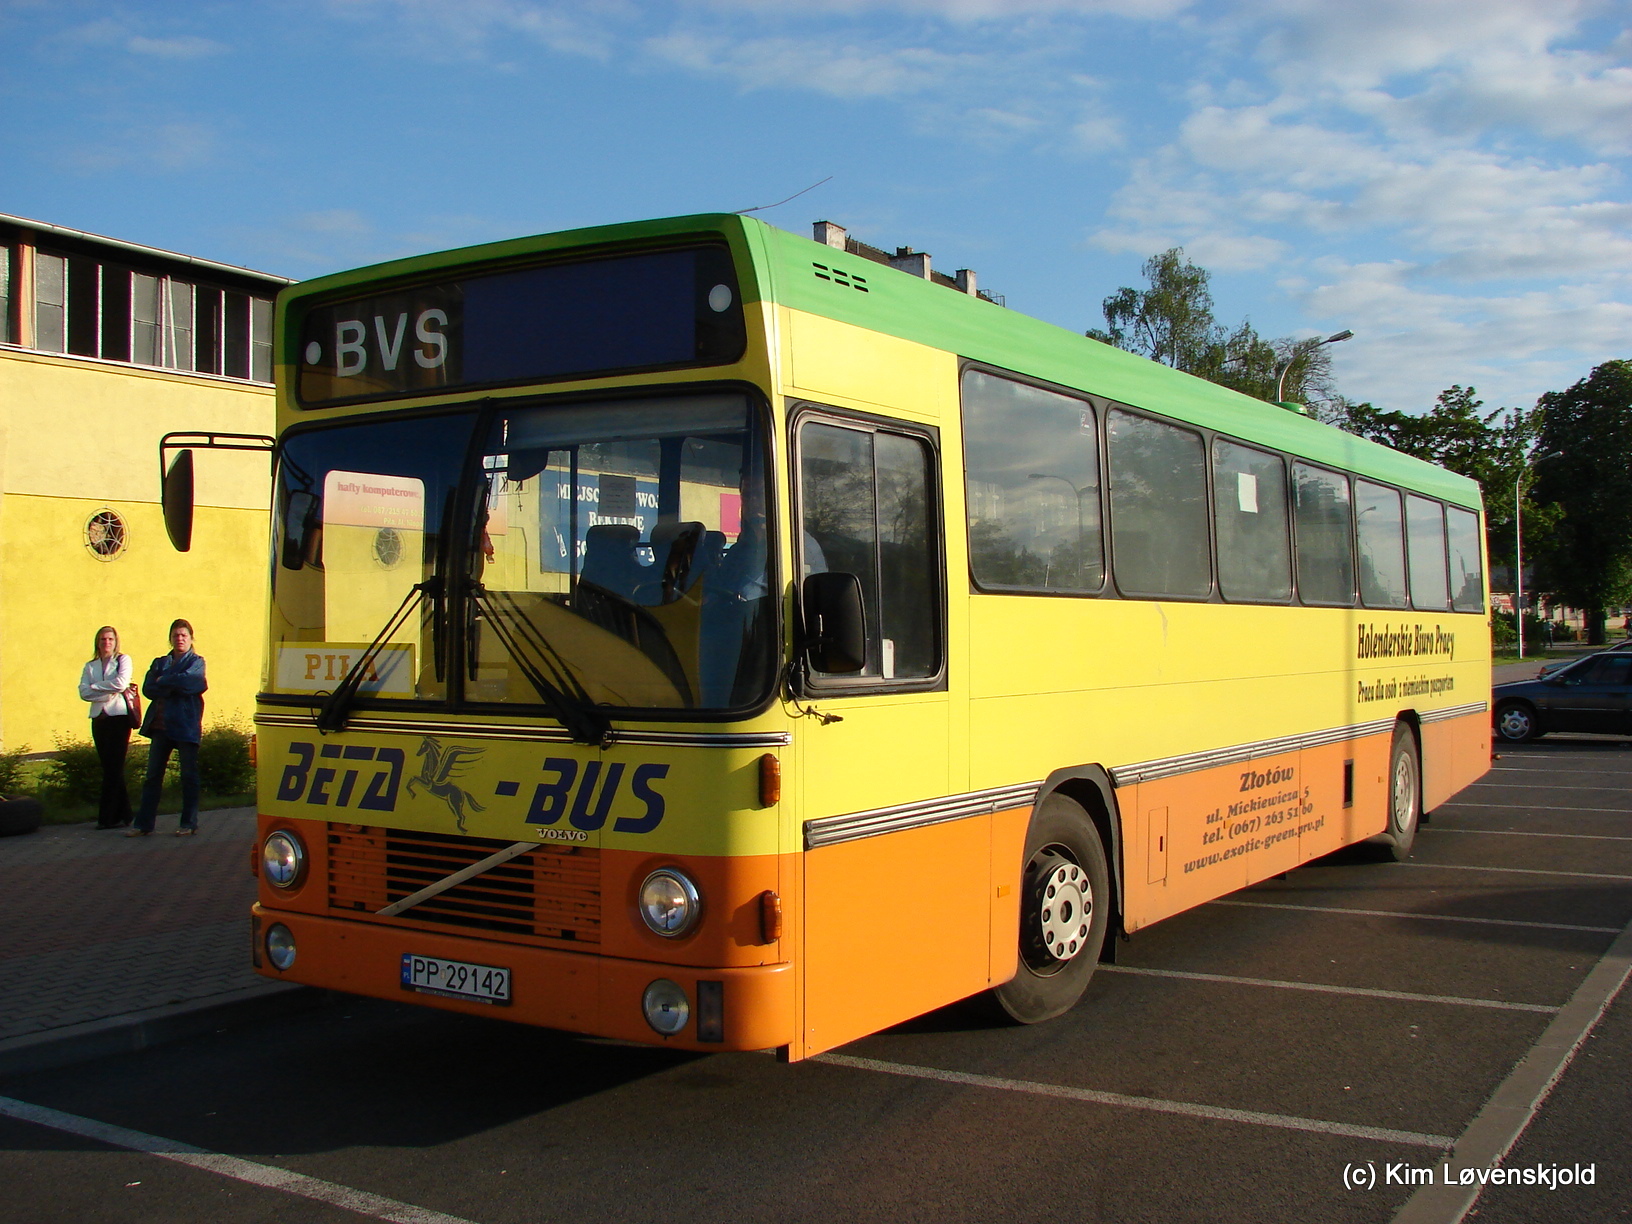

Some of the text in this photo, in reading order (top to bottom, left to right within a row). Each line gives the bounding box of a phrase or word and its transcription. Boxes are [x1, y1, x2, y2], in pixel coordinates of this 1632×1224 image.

[336, 308, 449, 377] BVS
[337, 482, 361, 495] hafty
[1357, 623, 1455, 661] Holenderskie Biuro Pracy
[1357, 680, 1374, 703] Praca
[1375, 678, 1384, 701] dla
[1385, 677, 1397, 700] osób
[276, 741, 406, 812] BETA
[1239, 765, 1294, 792] Złotów
[1205, 785, 1310, 825] ul. Mickiewicza 5
[536, 828, 588, 841] VOLVO
[1183, 815, 1325, 873] www.exotic-green.prv.pl
[1202, 827, 1224, 845] tel.
[1228, 815, 1262, 840] (067)
[1264, 810, 1284, 826] 263
[1286, 806, 1299, 821] 51
[413, 958, 440, 985] PP
[446, 964, 506, 997] 29142
